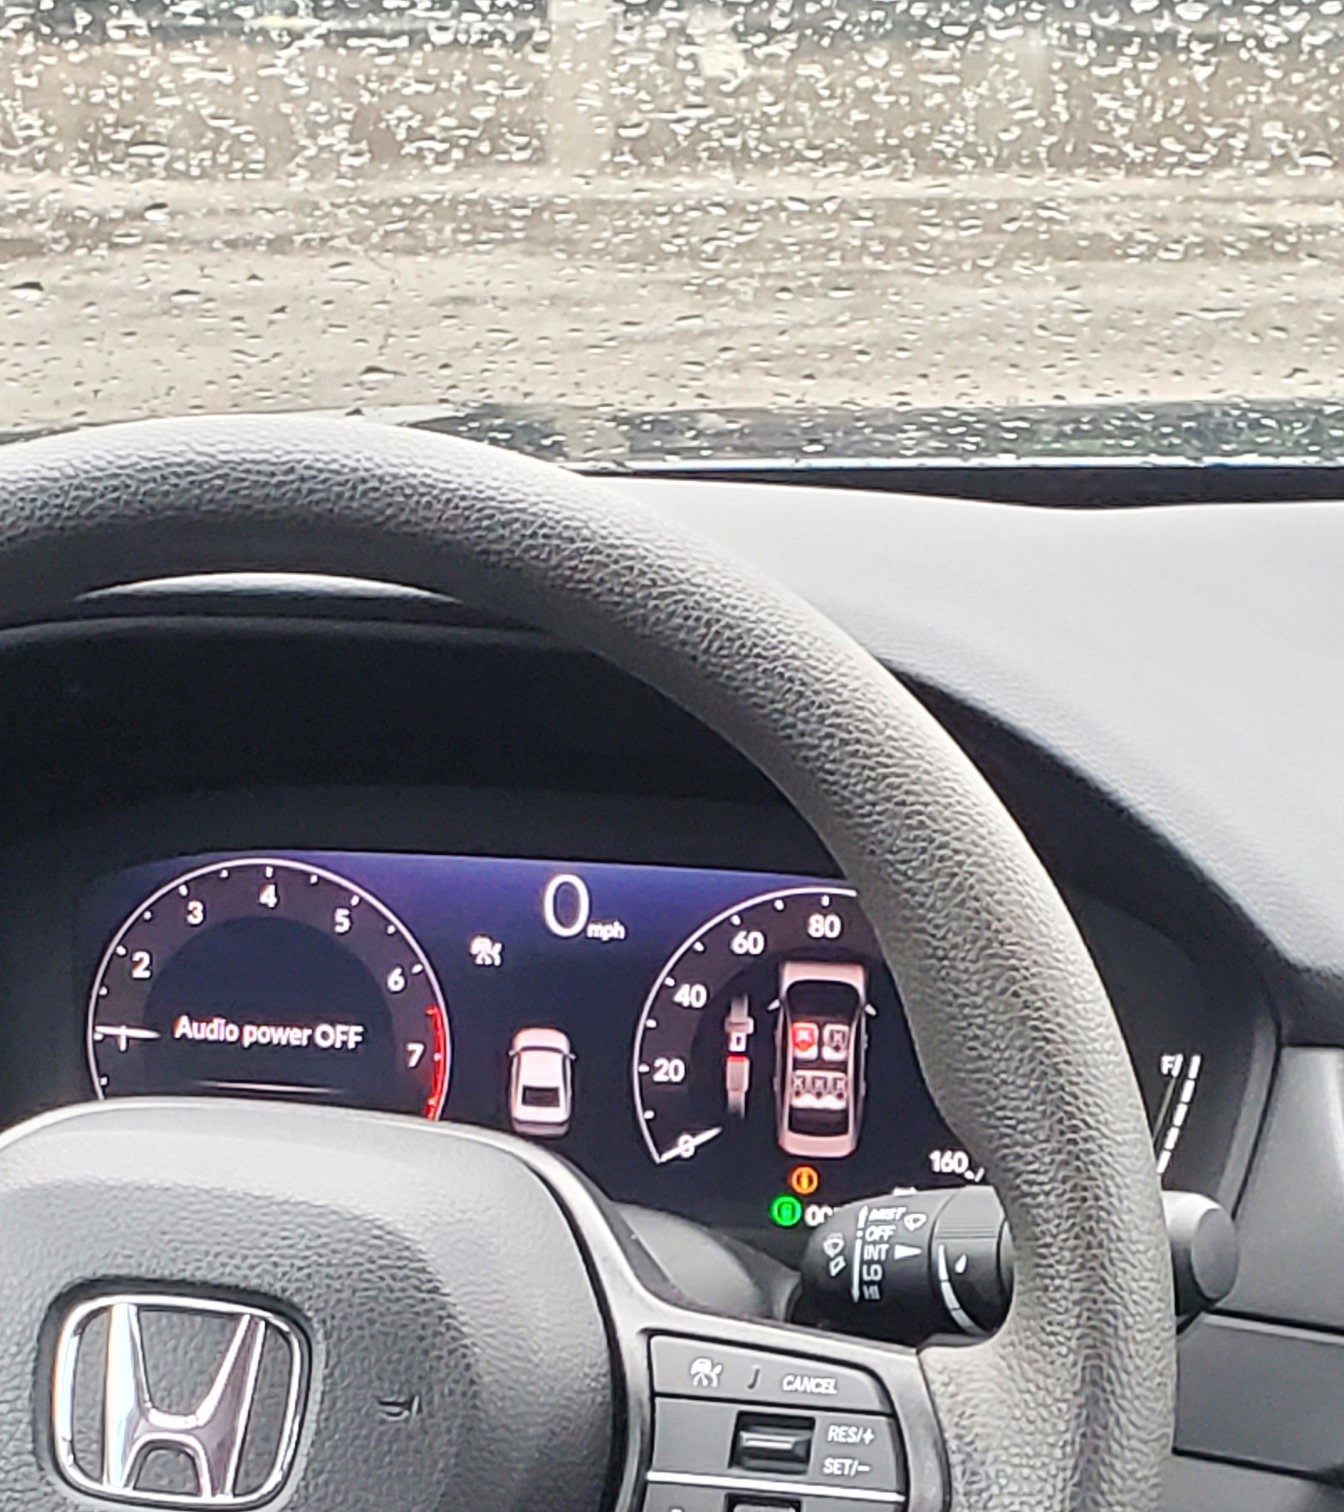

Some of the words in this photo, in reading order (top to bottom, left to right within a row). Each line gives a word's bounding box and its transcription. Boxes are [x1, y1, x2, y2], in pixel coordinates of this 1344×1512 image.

[259, 884, 278, 908] 4
[187, 902, 203, 925] 3
[334, 909, 350, 933] 5
[587, 921, 625, 942] mph
[808, 915, 841, 938] 80
[731, 931, 764, 955] 60
[131, 953, 151, 978] 2
[387, 967, 404, 991] 6
[674, 984, 707, 1008] 40
[174, 1016, 238, 1042] Audio
[243, 1022, 311, 1049] power
[314, 1024, 363, 1050] OFF
[407, 1044, 423, 1067] 7
[652, 1058, 685, 1082] 20
[929, 1149, 969, 1174] 160
[865, 1225, 896, 1242] OFF
[863, 1243, 890, 1261] INT
[862, 1264, 883, 1281] LO
[782, 1374, 838, 1395] CANCEL
